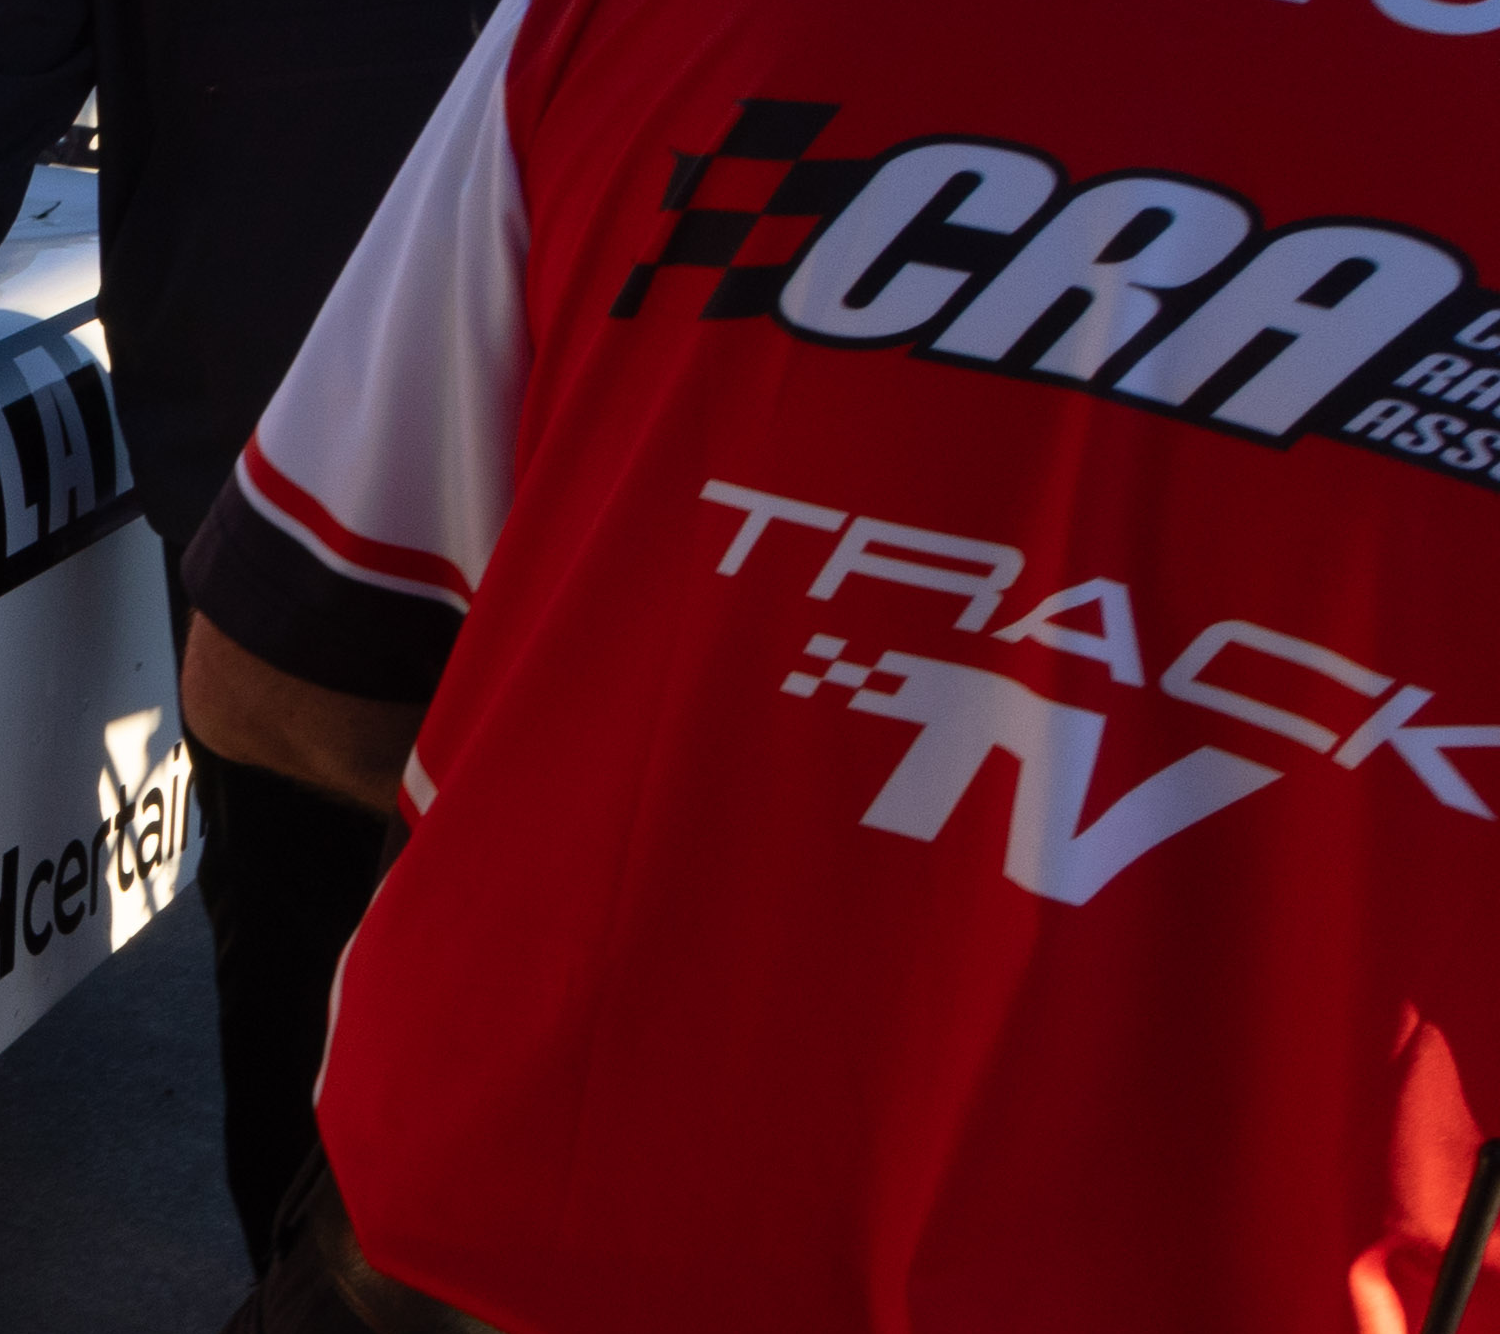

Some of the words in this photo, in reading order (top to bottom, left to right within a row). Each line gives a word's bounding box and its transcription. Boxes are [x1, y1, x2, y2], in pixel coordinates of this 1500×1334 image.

[779, 141, 1464, 435] CRA
[700, 478, 1500, 820] TRACK
[846, 649, 1285, 907] TV
